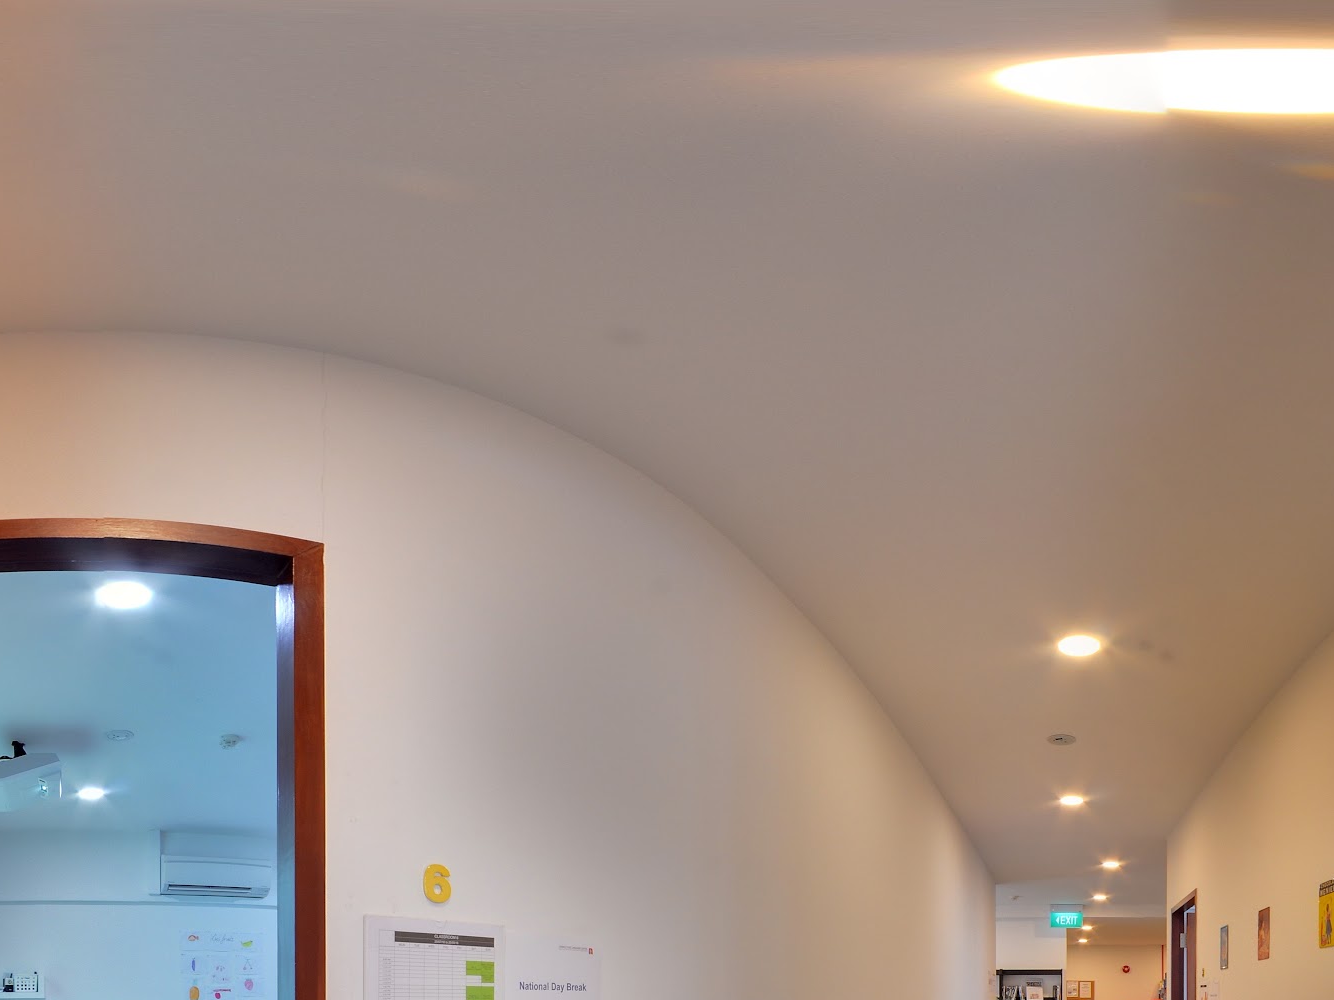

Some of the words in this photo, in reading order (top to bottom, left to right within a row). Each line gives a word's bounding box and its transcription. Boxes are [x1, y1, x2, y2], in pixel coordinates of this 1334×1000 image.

[423, 864, 451, 903] 6
[1060, 916, 1078, 925] EXIT
[519, 982, 549, 991] National
[551, 983, 564, 993] Day
[567, 983, 586, 991] Break
